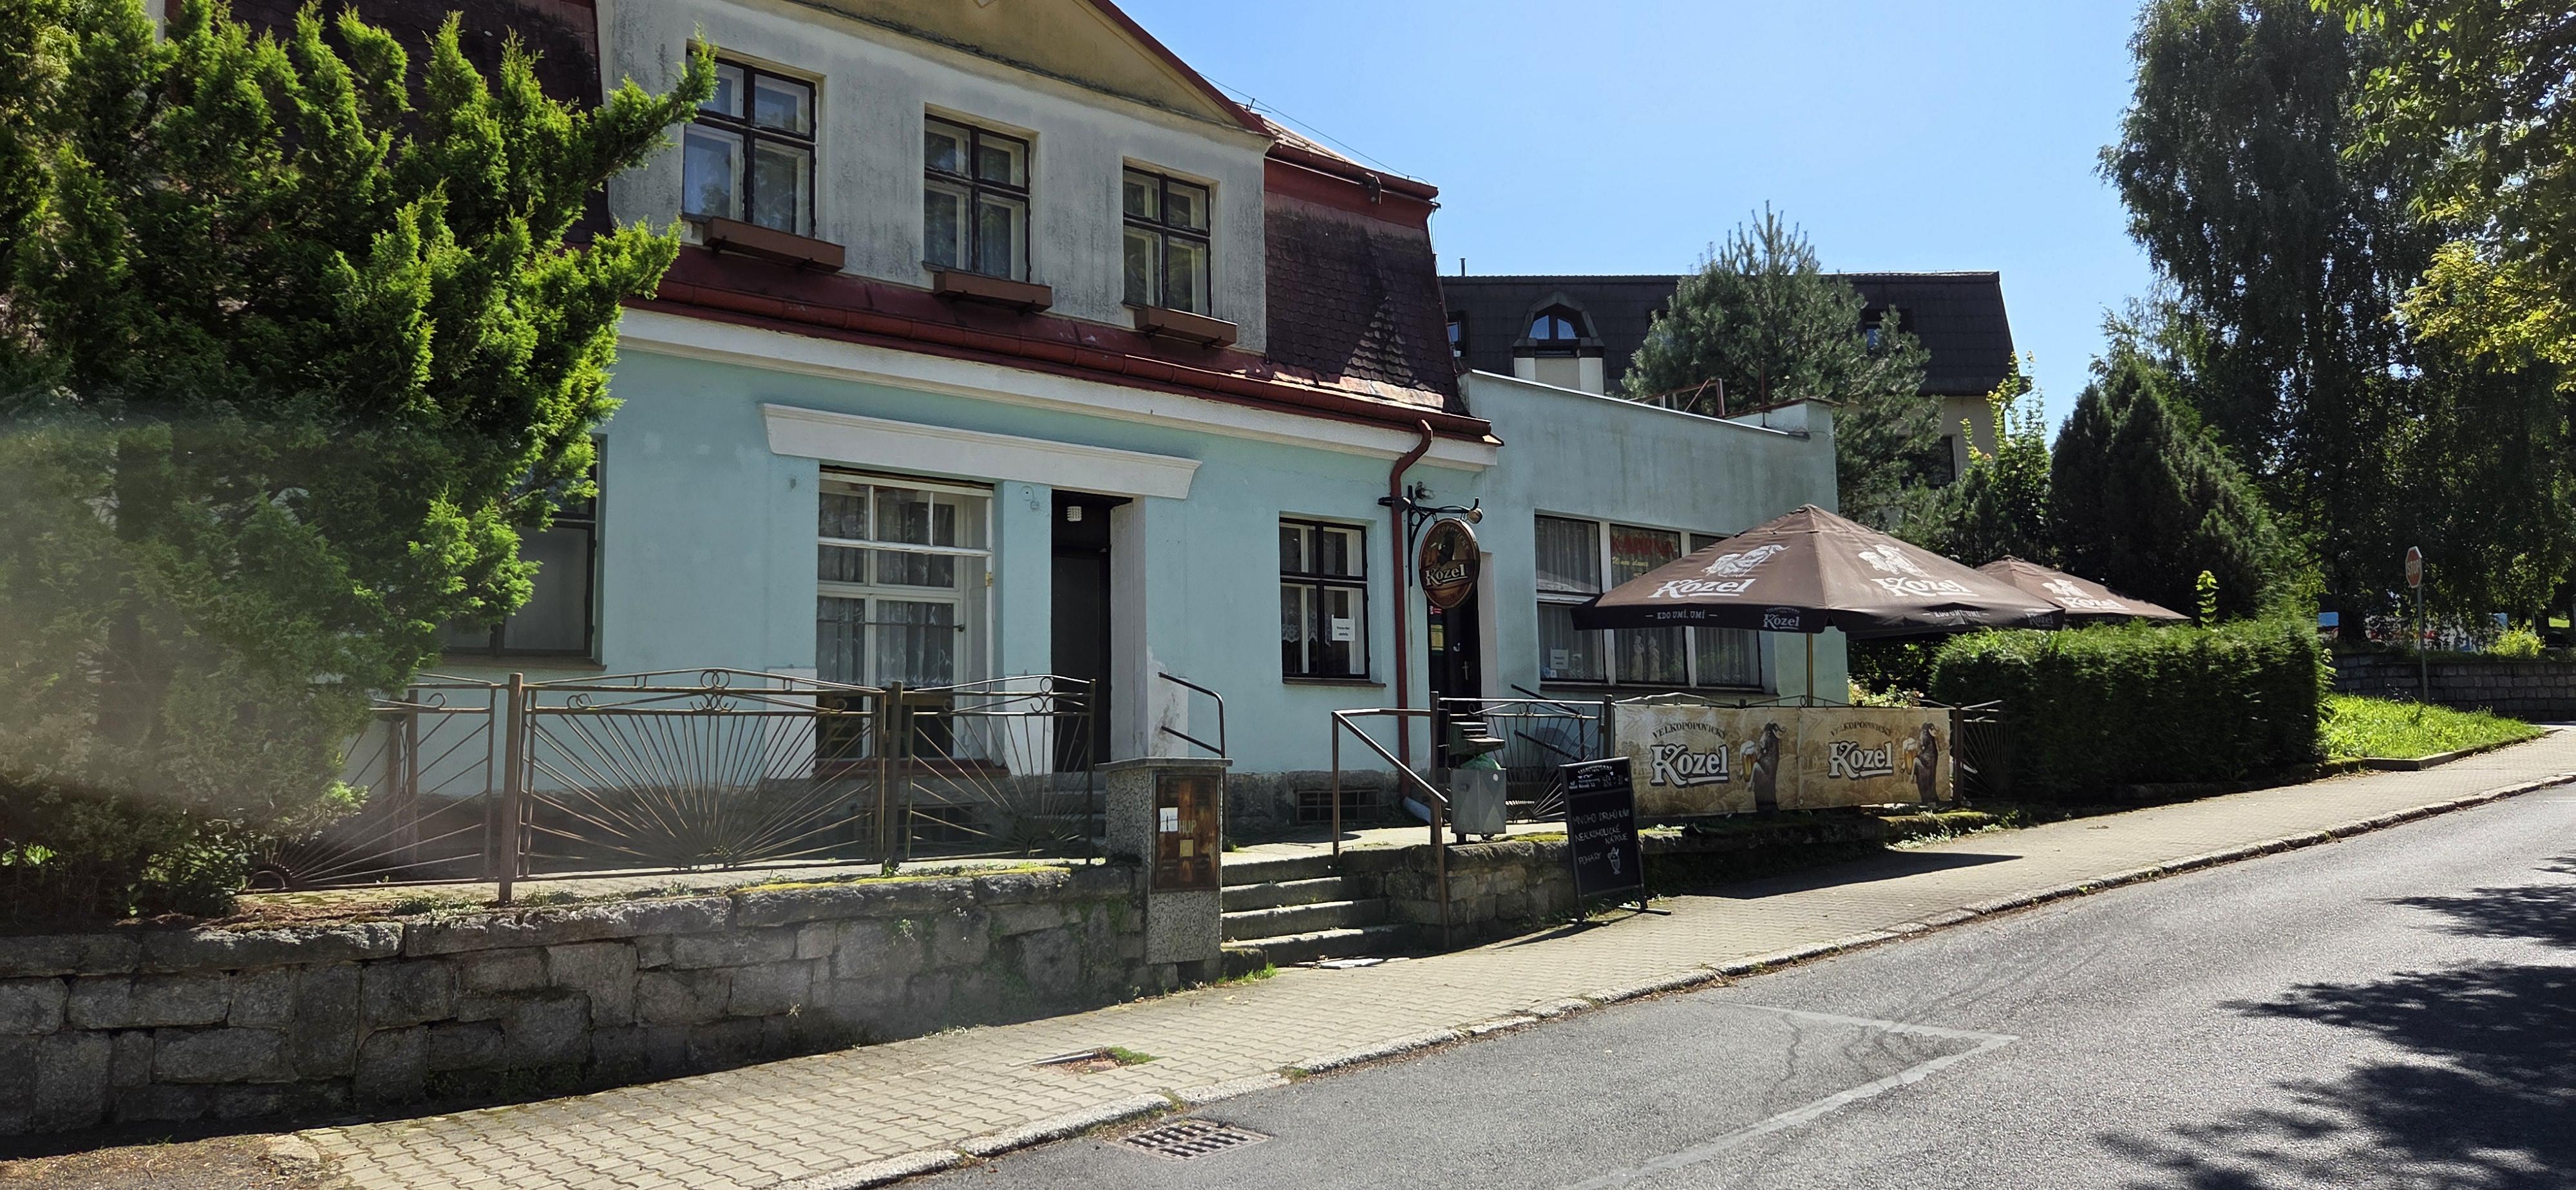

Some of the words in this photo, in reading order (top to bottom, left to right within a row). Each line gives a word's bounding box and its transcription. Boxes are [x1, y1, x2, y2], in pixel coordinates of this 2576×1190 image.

[1425, 563, 1467, 586] Kozel
[2407, 559, 2420, 576] STOP
[1647, 578, 1756, 599] Kozel
[1870, 577, 1976, 597] Kozel
[2054, 597, 2128, 609] Kozel
[1690, 609, 1706, 619] UMÍ
[1762, 614, 1800, 630] Kozel
[2025, 613, 2061, 627] Kozel
[1653, 721, 1727, 739] VELKOPOPOVICKÝ
[1650, 744, 1729, 787] Kozel
[1828, 741, 1893, 780] Kozel
[1179, 819, 1197, 835] HUP
[1572, 813, 1596, 825] MNOHO
